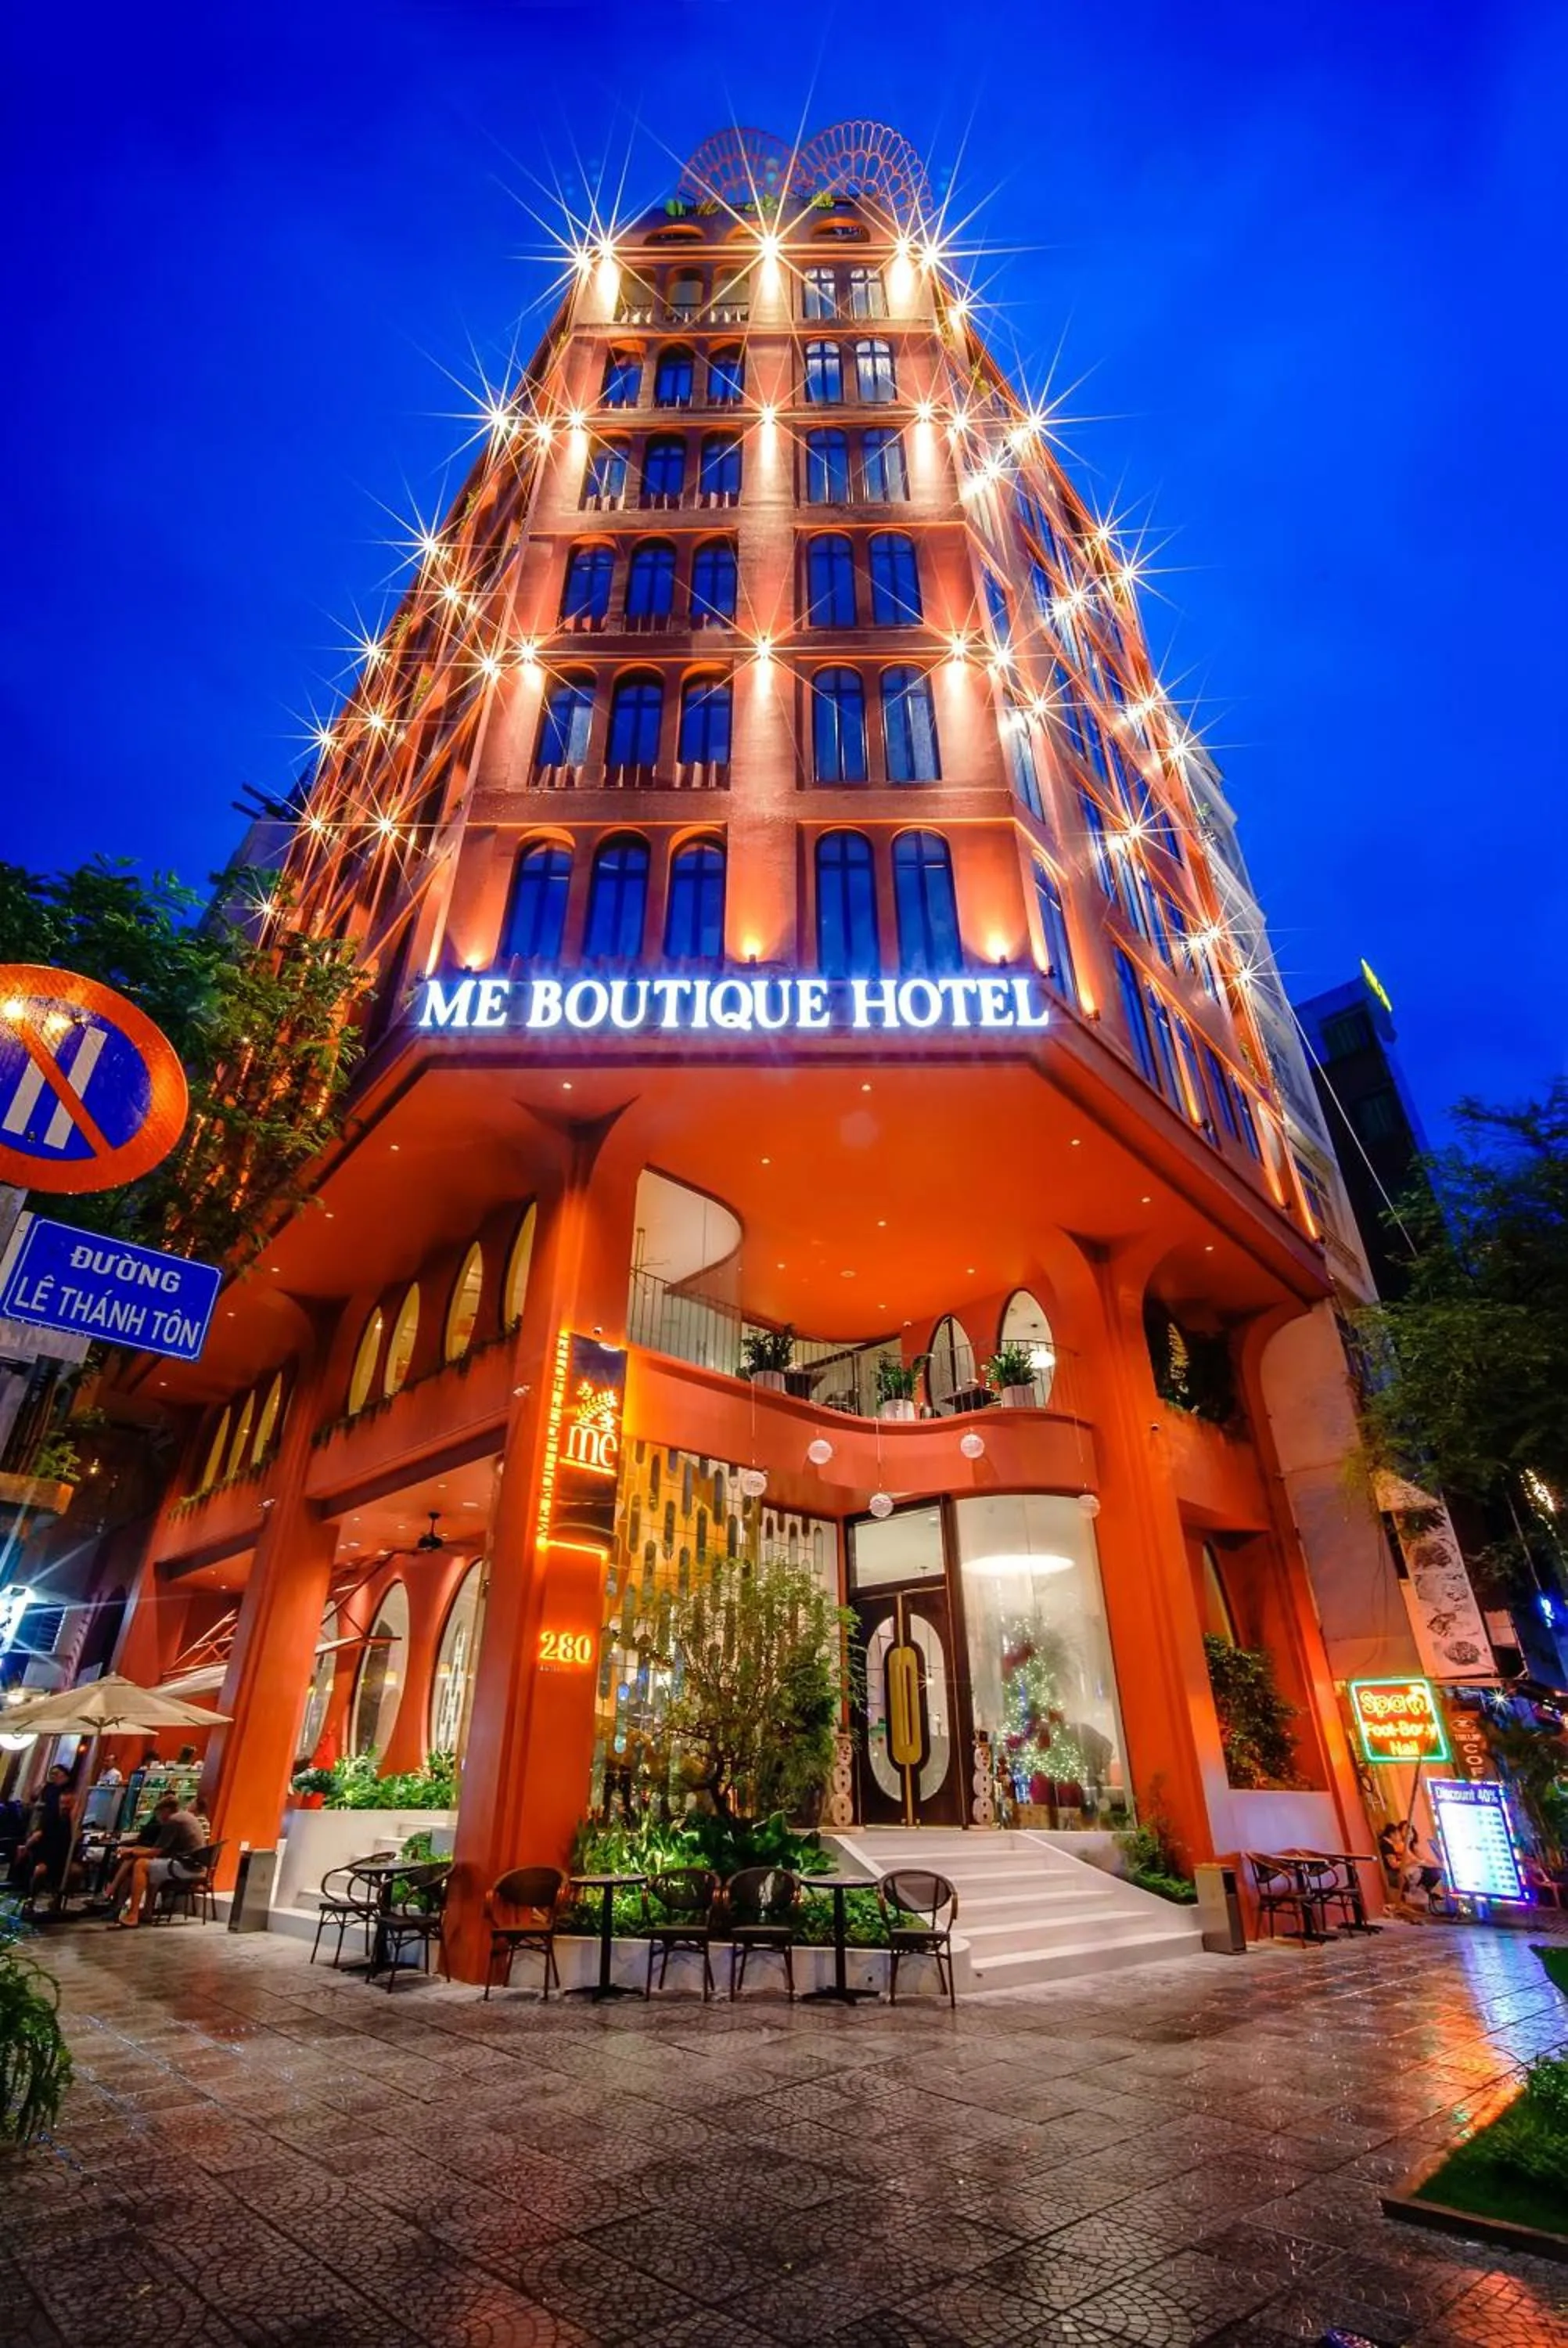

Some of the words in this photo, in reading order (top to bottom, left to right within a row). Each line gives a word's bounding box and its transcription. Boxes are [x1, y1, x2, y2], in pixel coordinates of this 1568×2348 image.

[419, 979, 509, 1028] ME
[526, 978, 830, 1032] BOUTIQUE
[852, 978, 1050, 1028] HOTEL
[70, 1245, 182, 1293] ĐƯỜNG
[14, 1274, 55, 1313] LÊ
[58, 1286, 147, 1336] THÁNH
[152, 1309, 201, 1349] TÔN
[568, 1424, 618, 1468] me
[539, 1630, 592, 1663] 280
